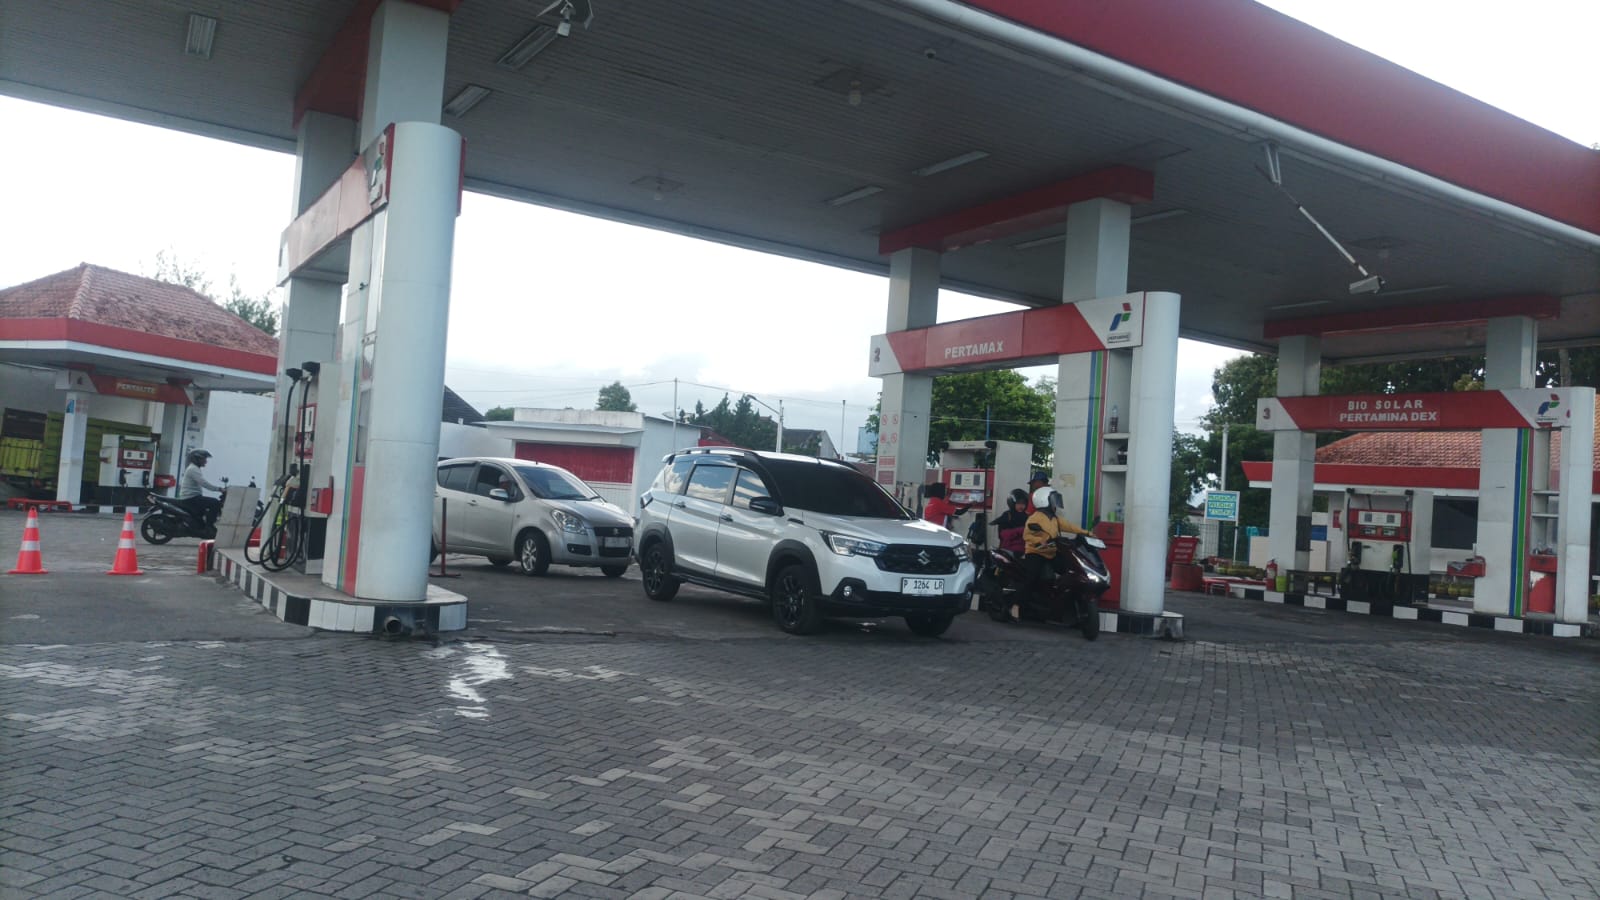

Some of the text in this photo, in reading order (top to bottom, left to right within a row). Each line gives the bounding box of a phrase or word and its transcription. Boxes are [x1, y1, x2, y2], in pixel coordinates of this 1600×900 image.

[873, 347, 881, 362] 2
[944, 340, 1004, 359] PERTAMAX
[1347, 399, 1424, 411] BIO SOLAR
[1263, 407, 1271, 420] 3
[1339, 411, 1438, 423] PERTAMINA DEX
[903, 579, 909, 589] P
